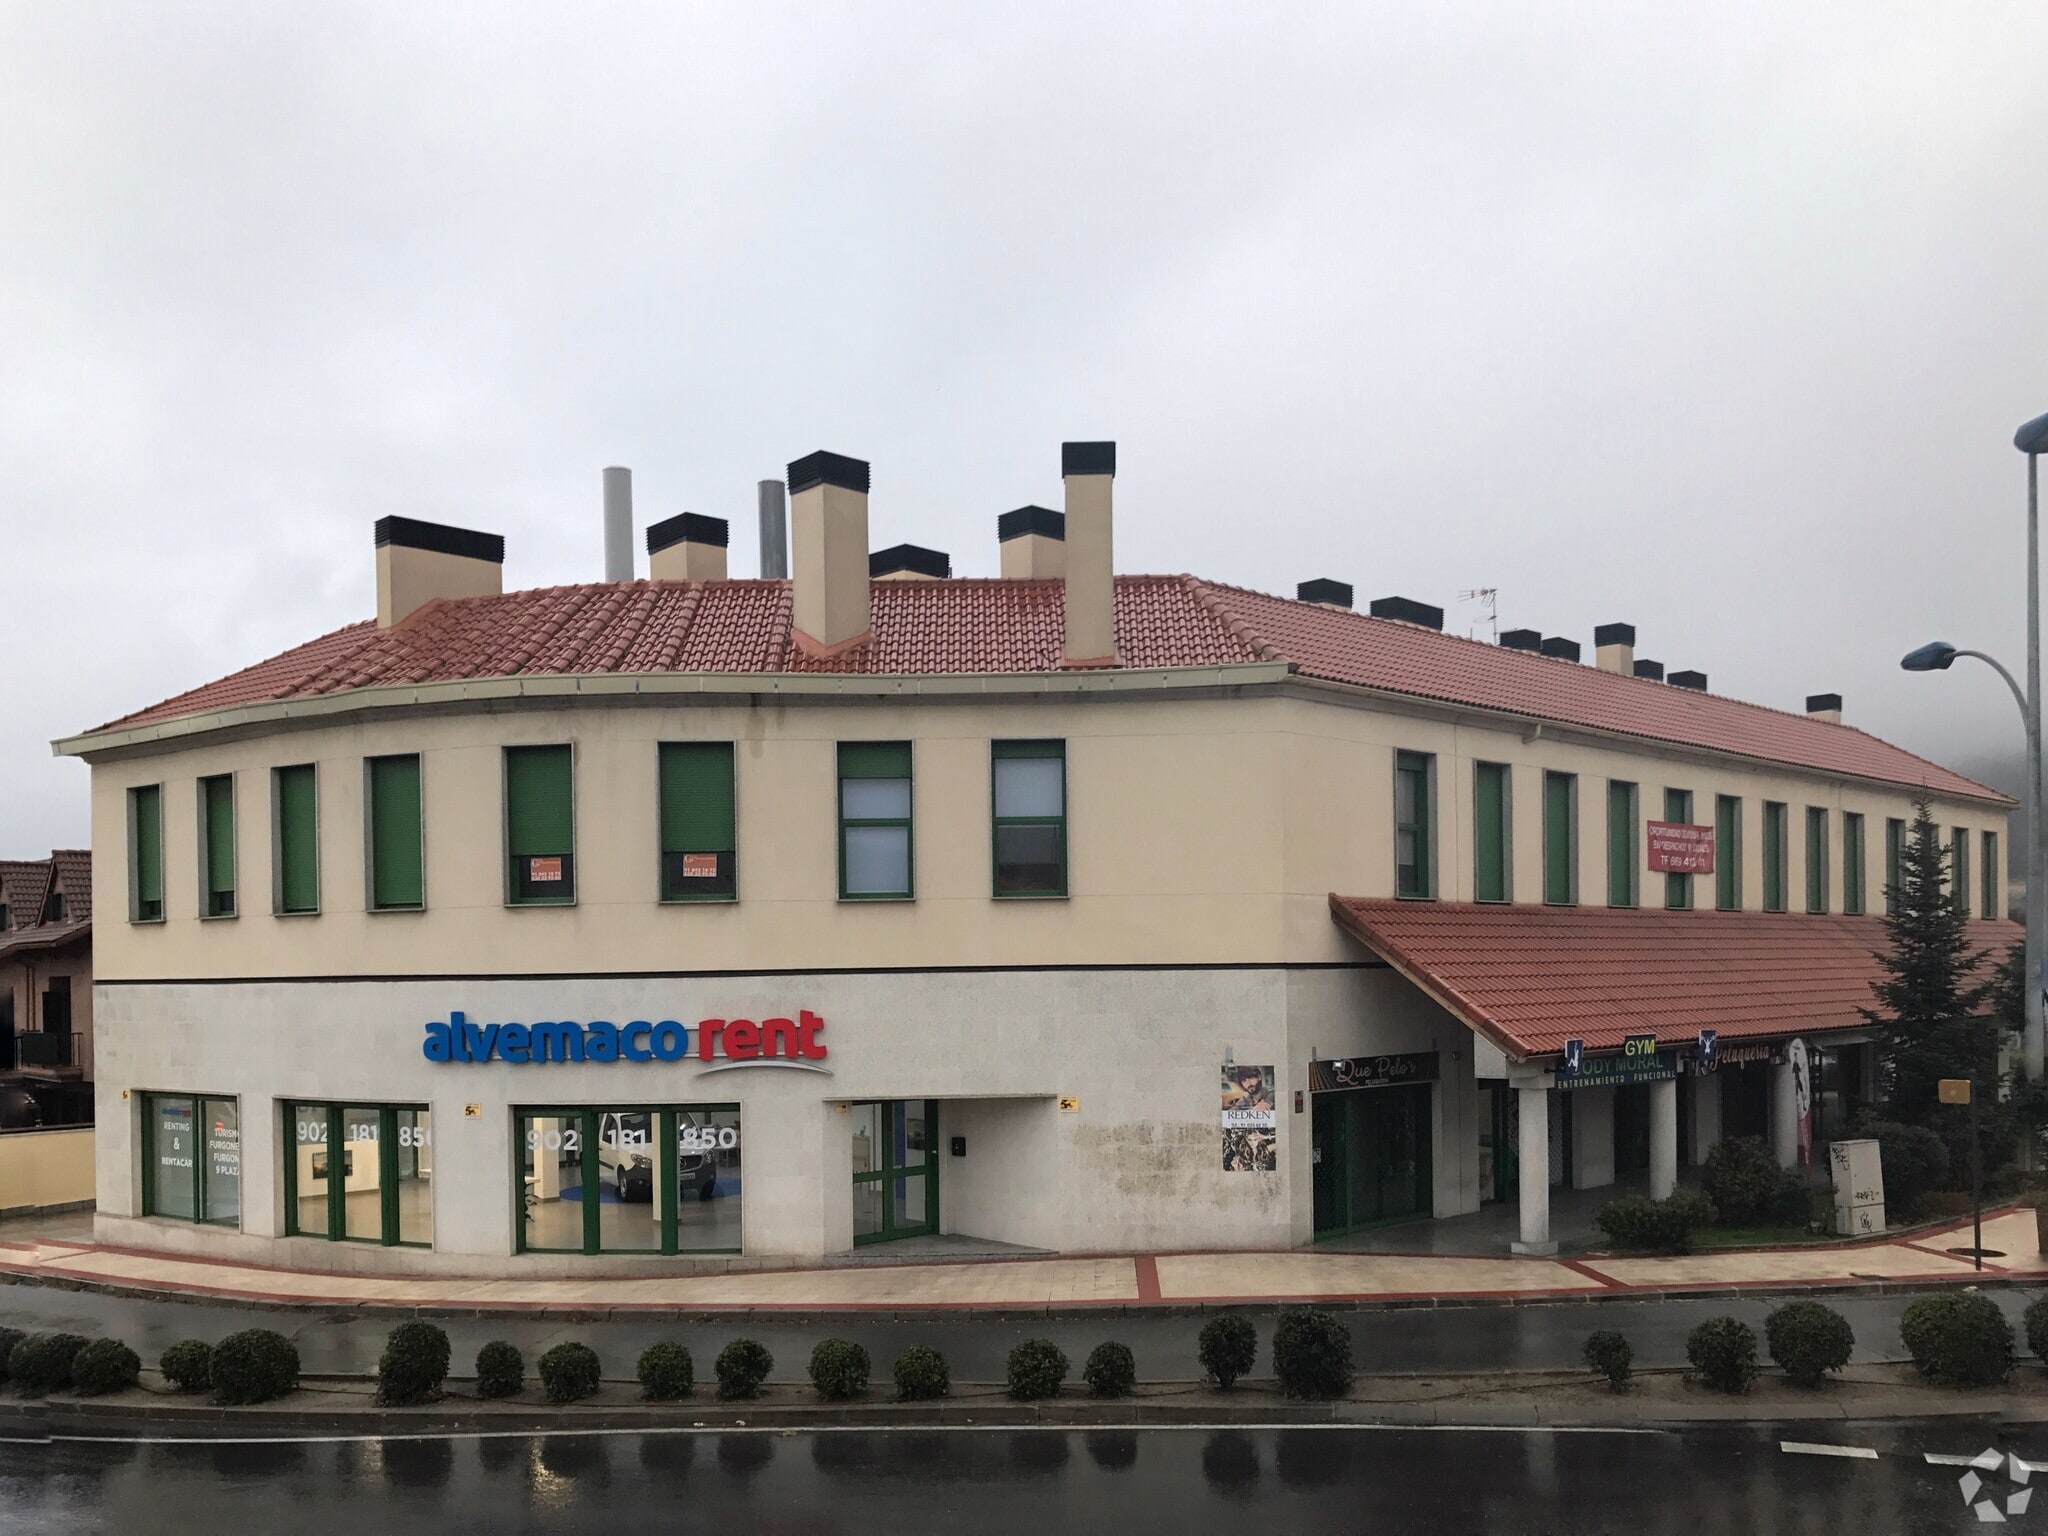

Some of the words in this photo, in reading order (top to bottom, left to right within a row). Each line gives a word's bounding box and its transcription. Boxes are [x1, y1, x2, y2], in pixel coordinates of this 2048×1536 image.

[422, 1011, 689, 1064] alvemaco
[699, 1009, 828, 1062] rent
[1624, 1039, 1655, 1056] GYM
[1335, 1059, 1373, 1086] Que
[1571, 1056, 1608, 1076] ODY
[1615, 1053, 1664, 1072] MORAL
[1558, 1074, 1625, 1090] ENTRENAMIENTO
[1633, 1072, 1677, 1082] FUNCIONAL
[1227, 1110, 1271, 1120] REDKEN
[163, 1121, 190, 1132] RENTING
[297, 1121, 328, 1143] 902
[350, 1123, 379, 1143] 181
[173, 1137, 180, 1151] &
[526, 1128, 580, 1152] 902
[606, 1128, 647, 1151] 181
[682, 1127, 738, 1150] 850
[161, 1156, 193, 1168] RENTACAR
[215, 1165, 221, 1175] 9
